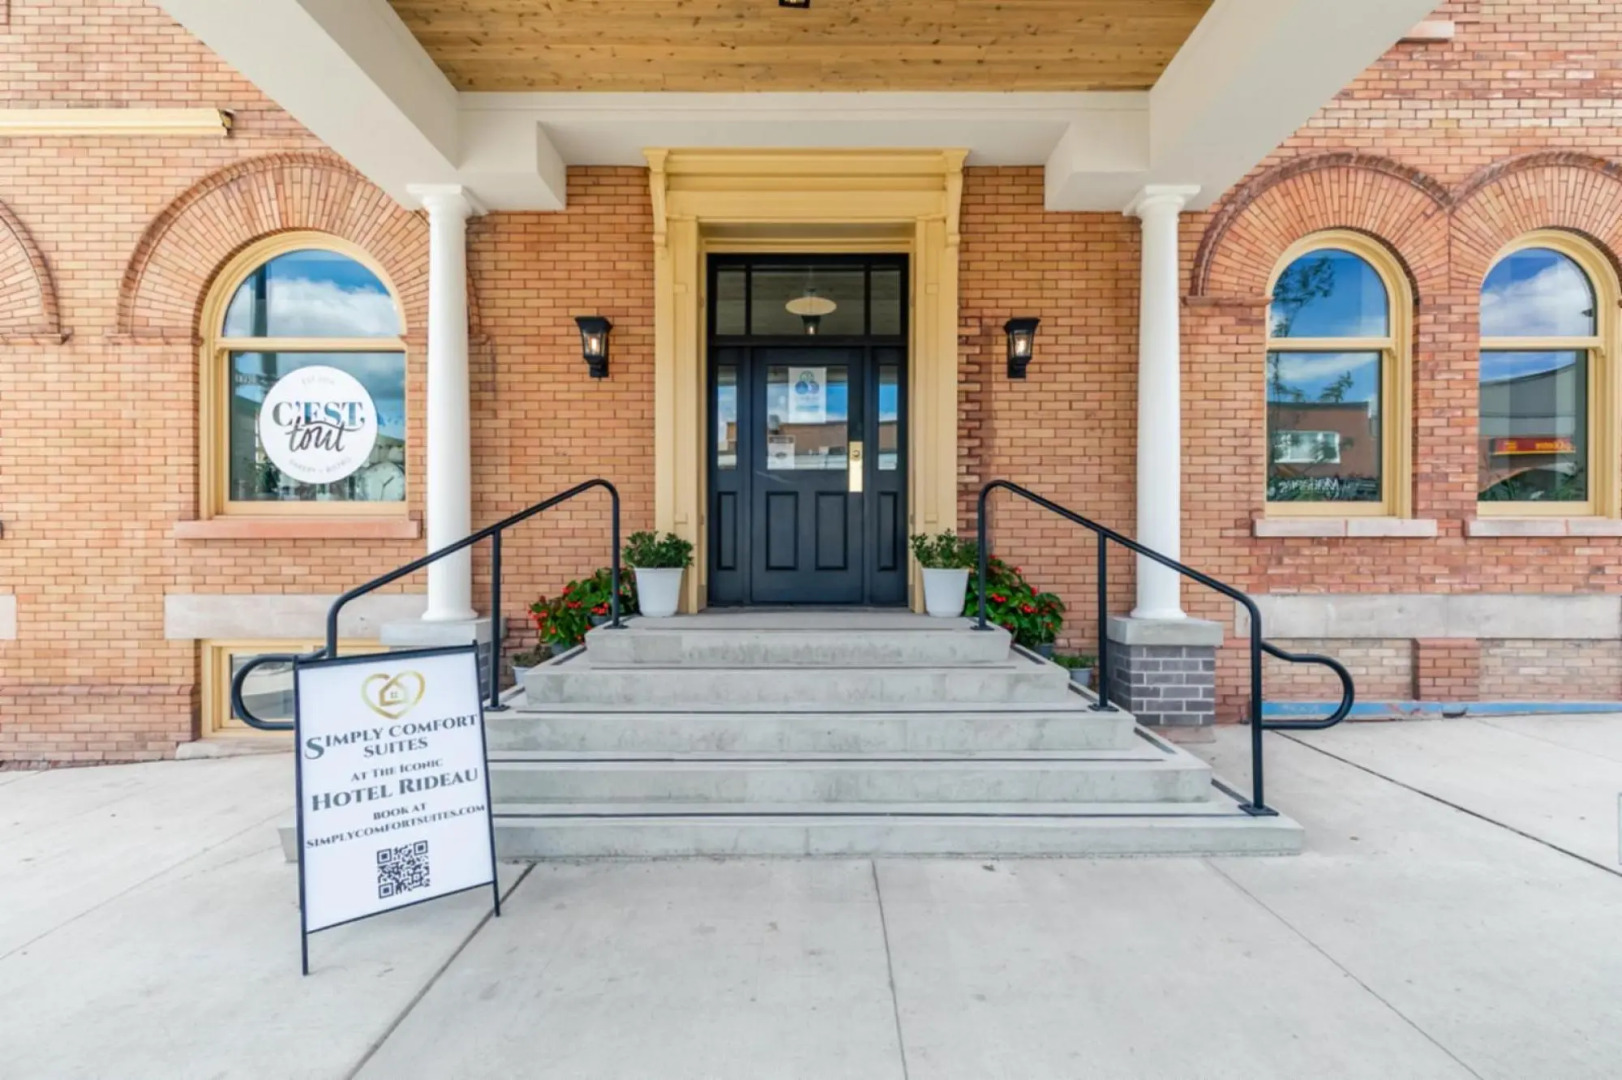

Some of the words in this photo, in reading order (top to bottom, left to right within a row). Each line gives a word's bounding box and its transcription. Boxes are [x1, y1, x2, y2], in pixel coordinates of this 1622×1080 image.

[272, 401, 364, 428] C'EST
[285, 416, 346, 453] tout
[304, 727, 384, 760] SIMPLY
[389, 714, 478, 738] COMFORT
[363, 737, 429, 759] SUITES
[351, 771, 367, 783] AT
[372, 767, 397, 779] THE
[400, 758, 444, 774] ICONIC
[311, 784, 393, 812] HOTEL
[399, 767, 478, 796] RIDEAU
[306, 803, 486, 849] SIMPLYCOMFORTSUITES.COM
[373, 805, 409, 821] BOOK
[412, 802, 427, 812] AT
